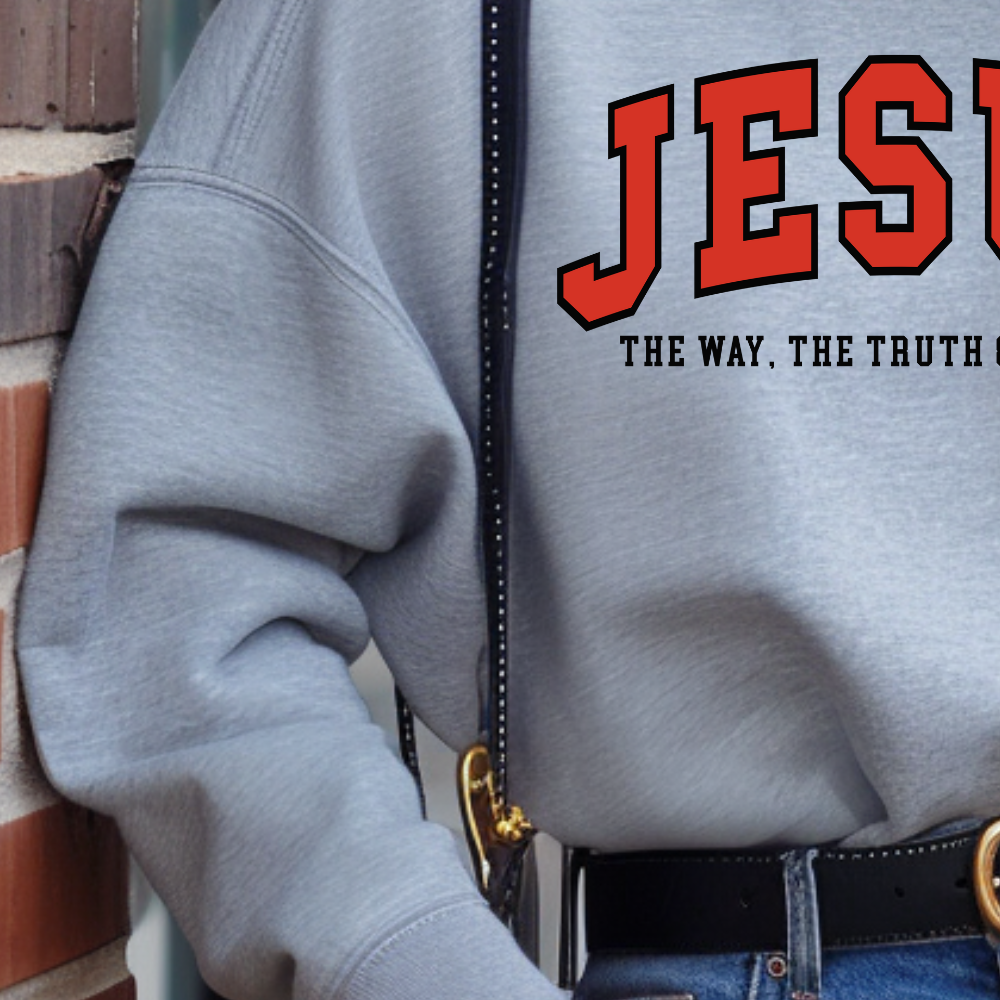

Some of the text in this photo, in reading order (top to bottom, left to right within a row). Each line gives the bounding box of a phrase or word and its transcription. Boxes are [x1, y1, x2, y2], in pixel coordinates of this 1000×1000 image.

[620, 336, 684, 367] THE
[698, 336, 775, 370] WAY,
[789, 336, 852, 367] THE
[867, 336, 982, 367] TRUTH
